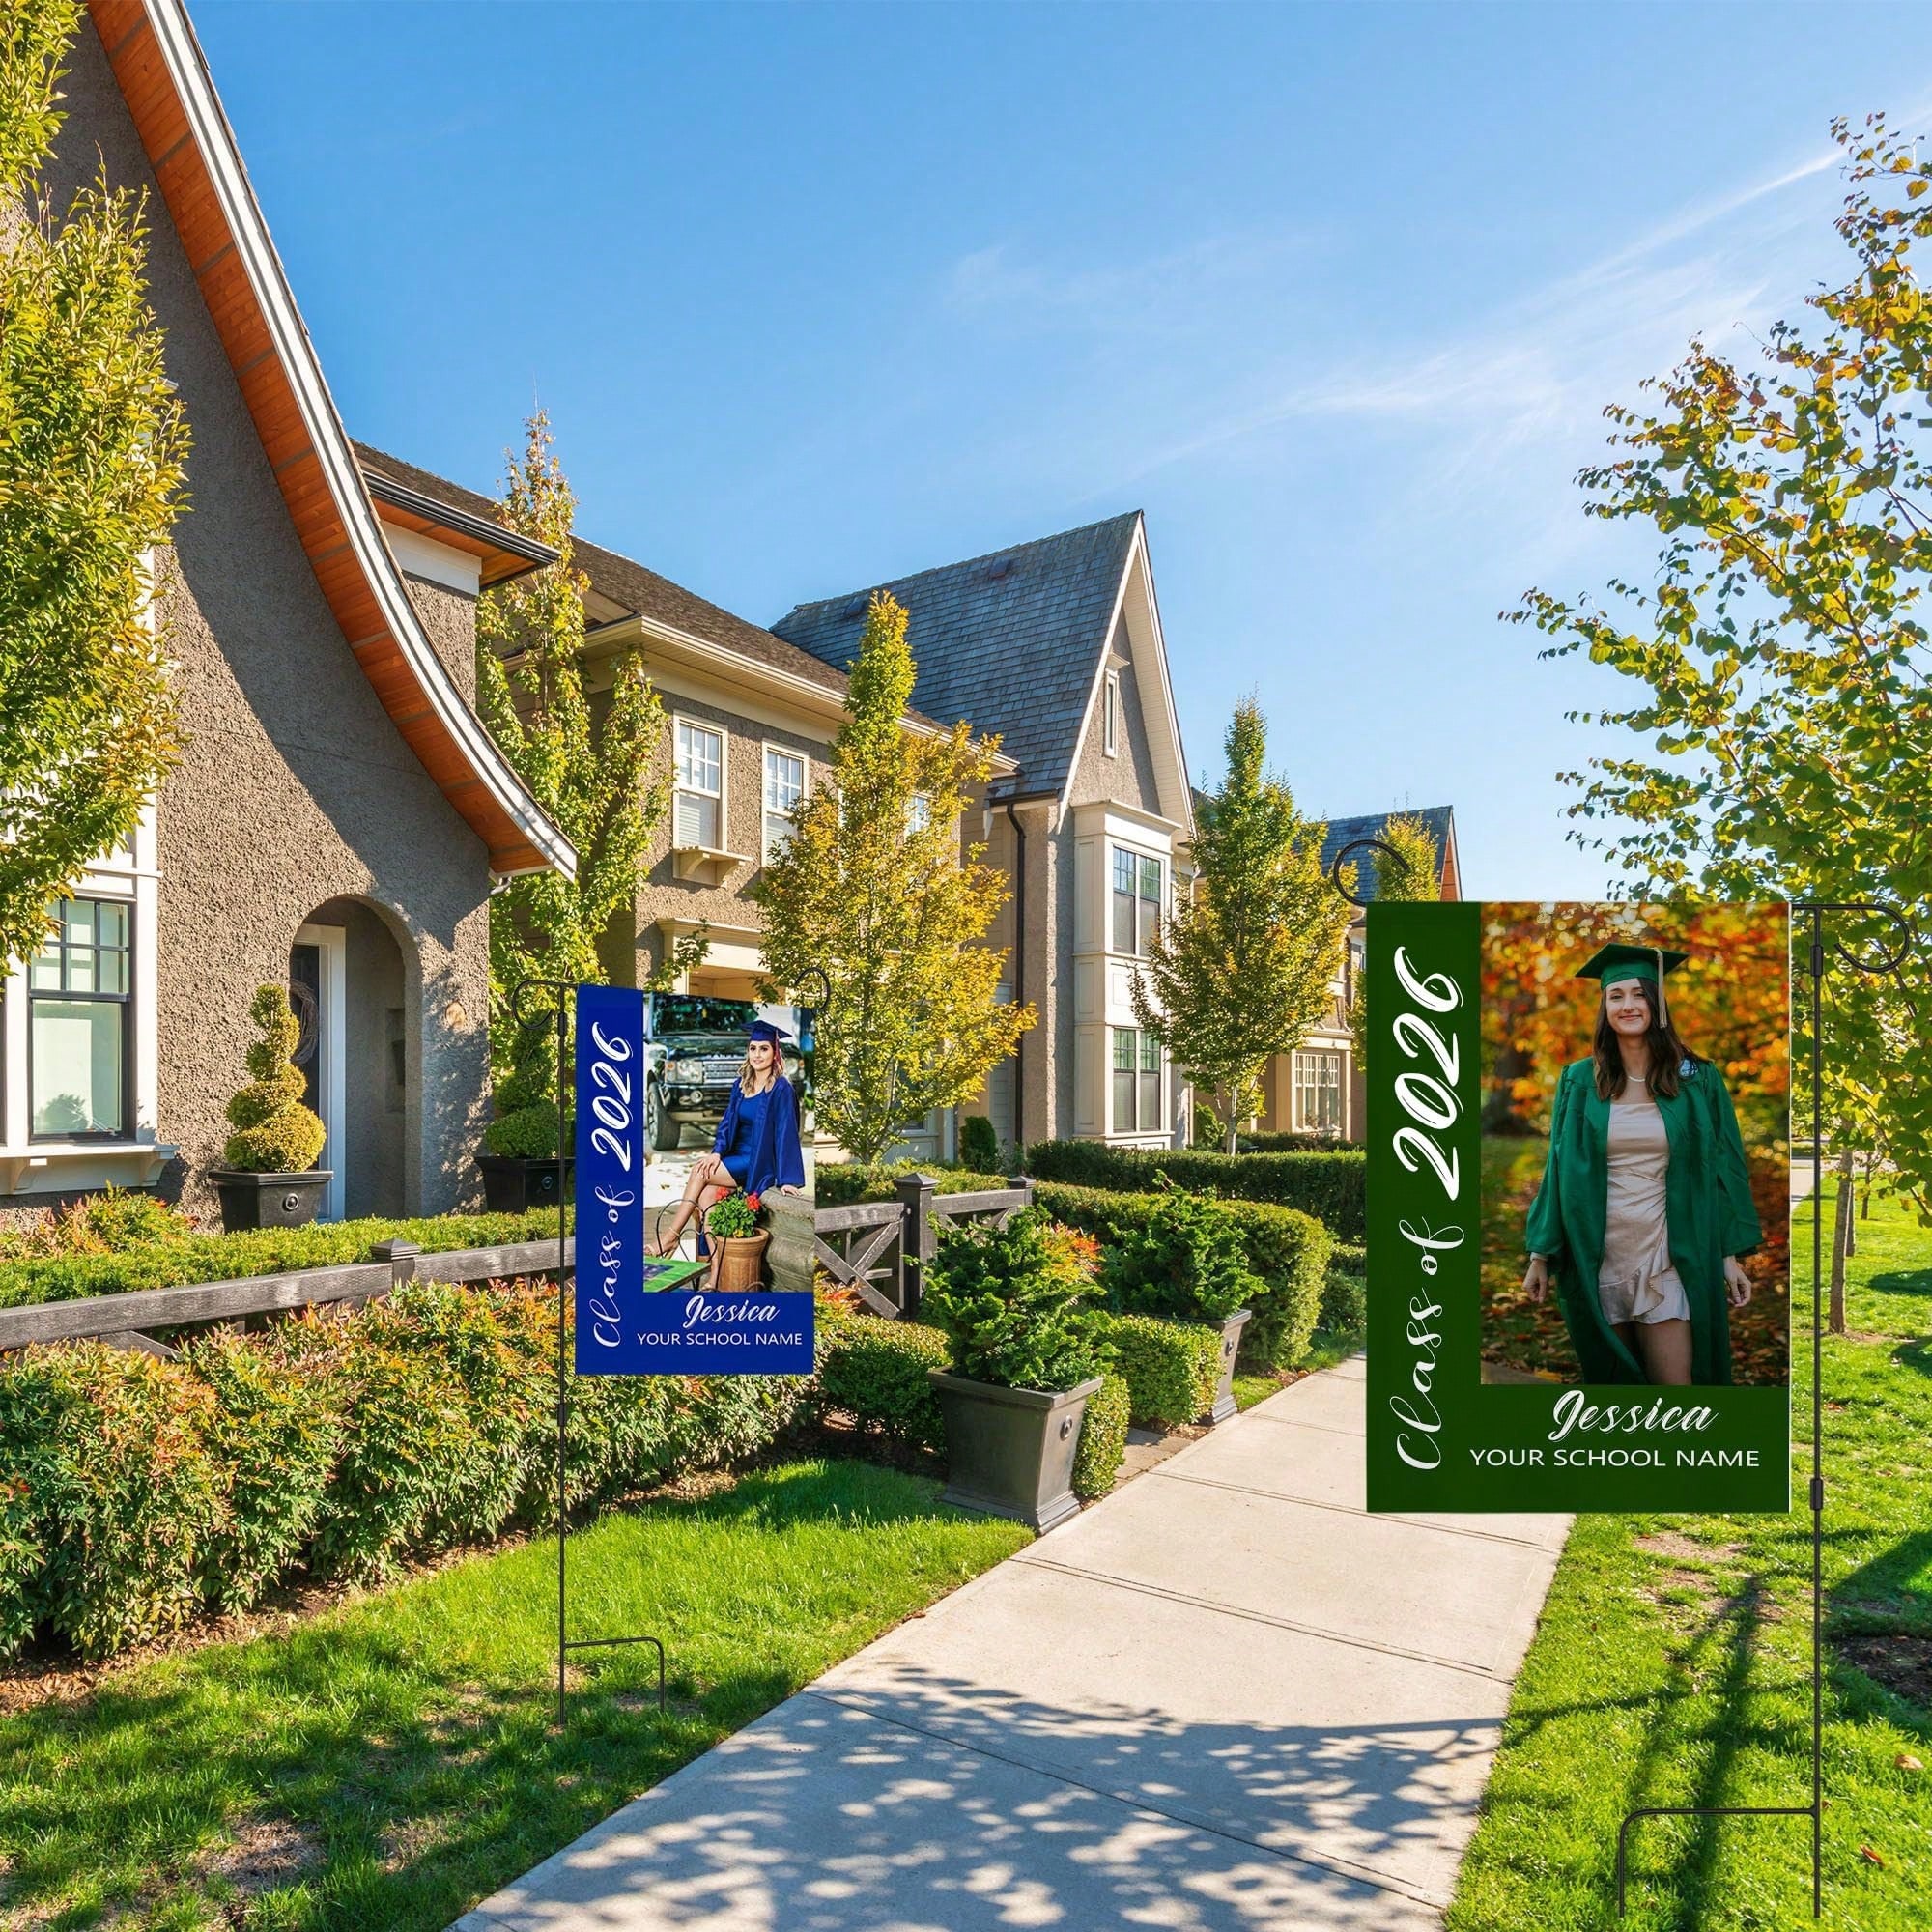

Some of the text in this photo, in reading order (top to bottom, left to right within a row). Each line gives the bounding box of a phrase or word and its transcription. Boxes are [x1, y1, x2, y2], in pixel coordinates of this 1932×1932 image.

[589, 1022, 634, 1348] Class of 2026
[1389, 946, 1464, 1470] Class of 2026
[683, 1295, 780, 1329] Jessica
[637, 1333, 802, 1346] YOUR SCHOOL NAME
[1548, 1389, 1719, 1442] Jessica
[1470, 1449, 1759, 1467] YOUR SCHOOL NAME
